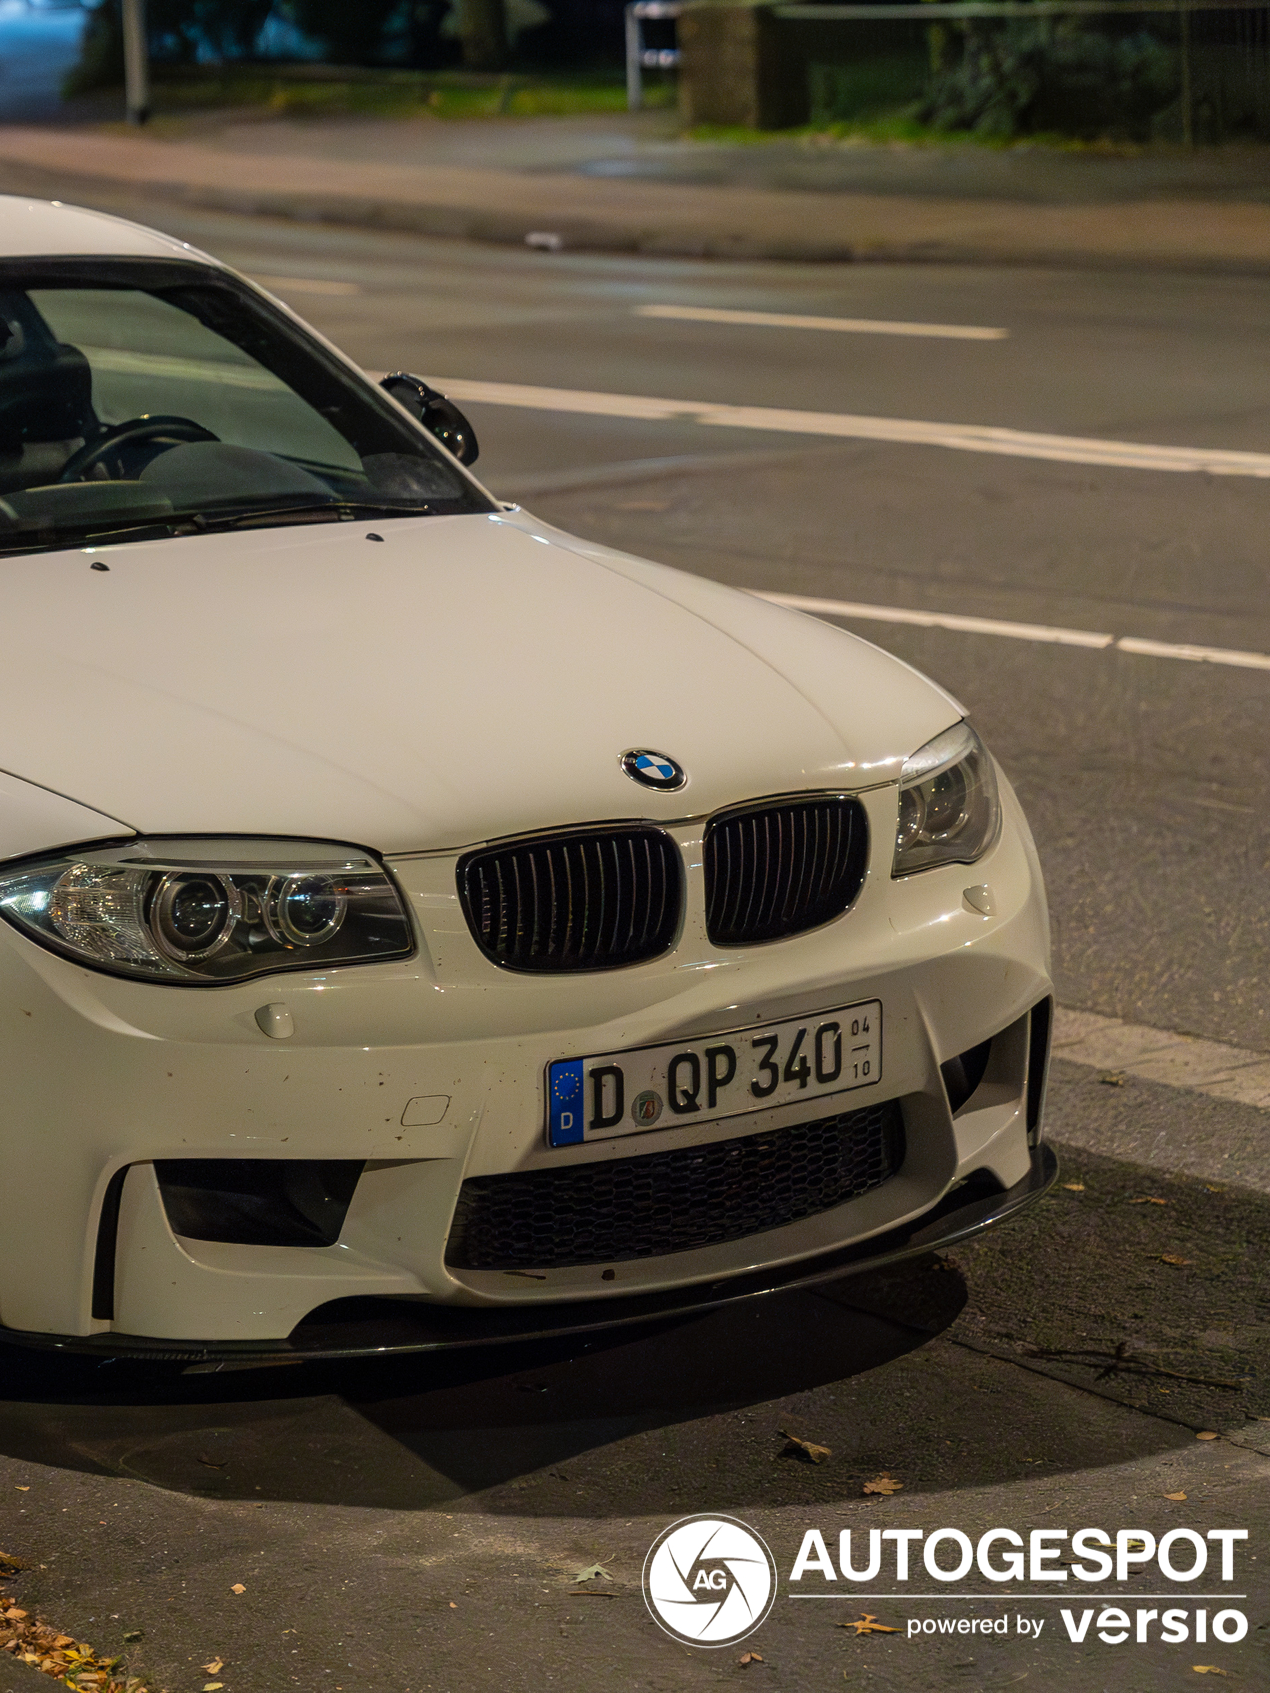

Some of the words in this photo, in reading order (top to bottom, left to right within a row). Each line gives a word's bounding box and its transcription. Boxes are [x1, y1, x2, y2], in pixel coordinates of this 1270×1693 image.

[850, 1015, 871, 1036] 04
[589, 1064, 625, 1131] D
[667, 1043, 737, 1114] QP
[750, 1020, 843, 1099] 340
[852, 1059, 871, 1079] 10
[560, 1111, 574, 1130] D
